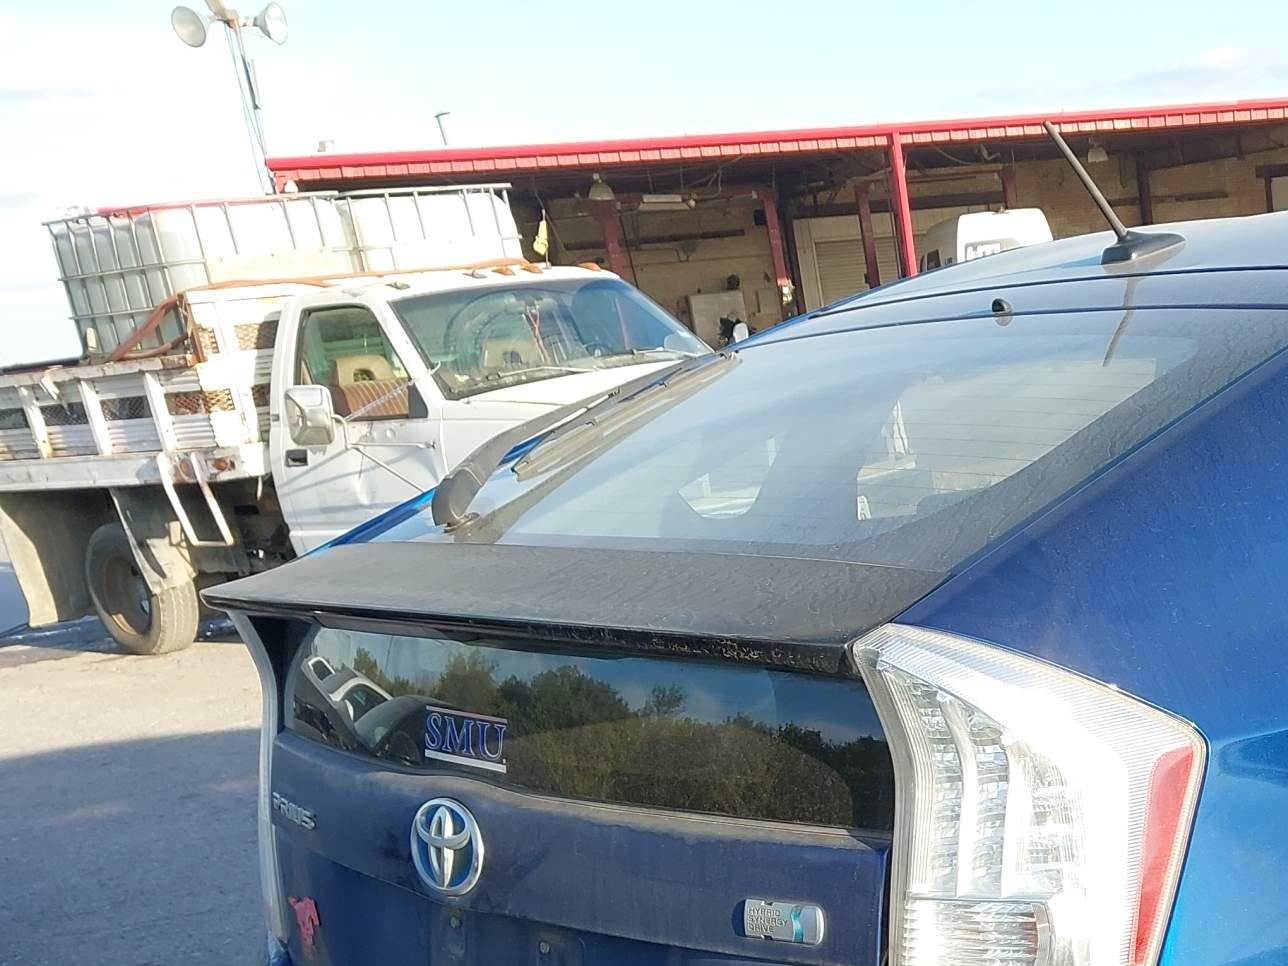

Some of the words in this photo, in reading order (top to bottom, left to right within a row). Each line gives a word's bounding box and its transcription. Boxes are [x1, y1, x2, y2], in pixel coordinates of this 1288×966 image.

[425, 712, 507, 761] SMU
[272, 791, 316, 831] PRIUS
[748, 906, 781, 917] HYBRID
[747, 914, 788, 928] SYNERGY
[748, 923, 775, 934] DRIVE
